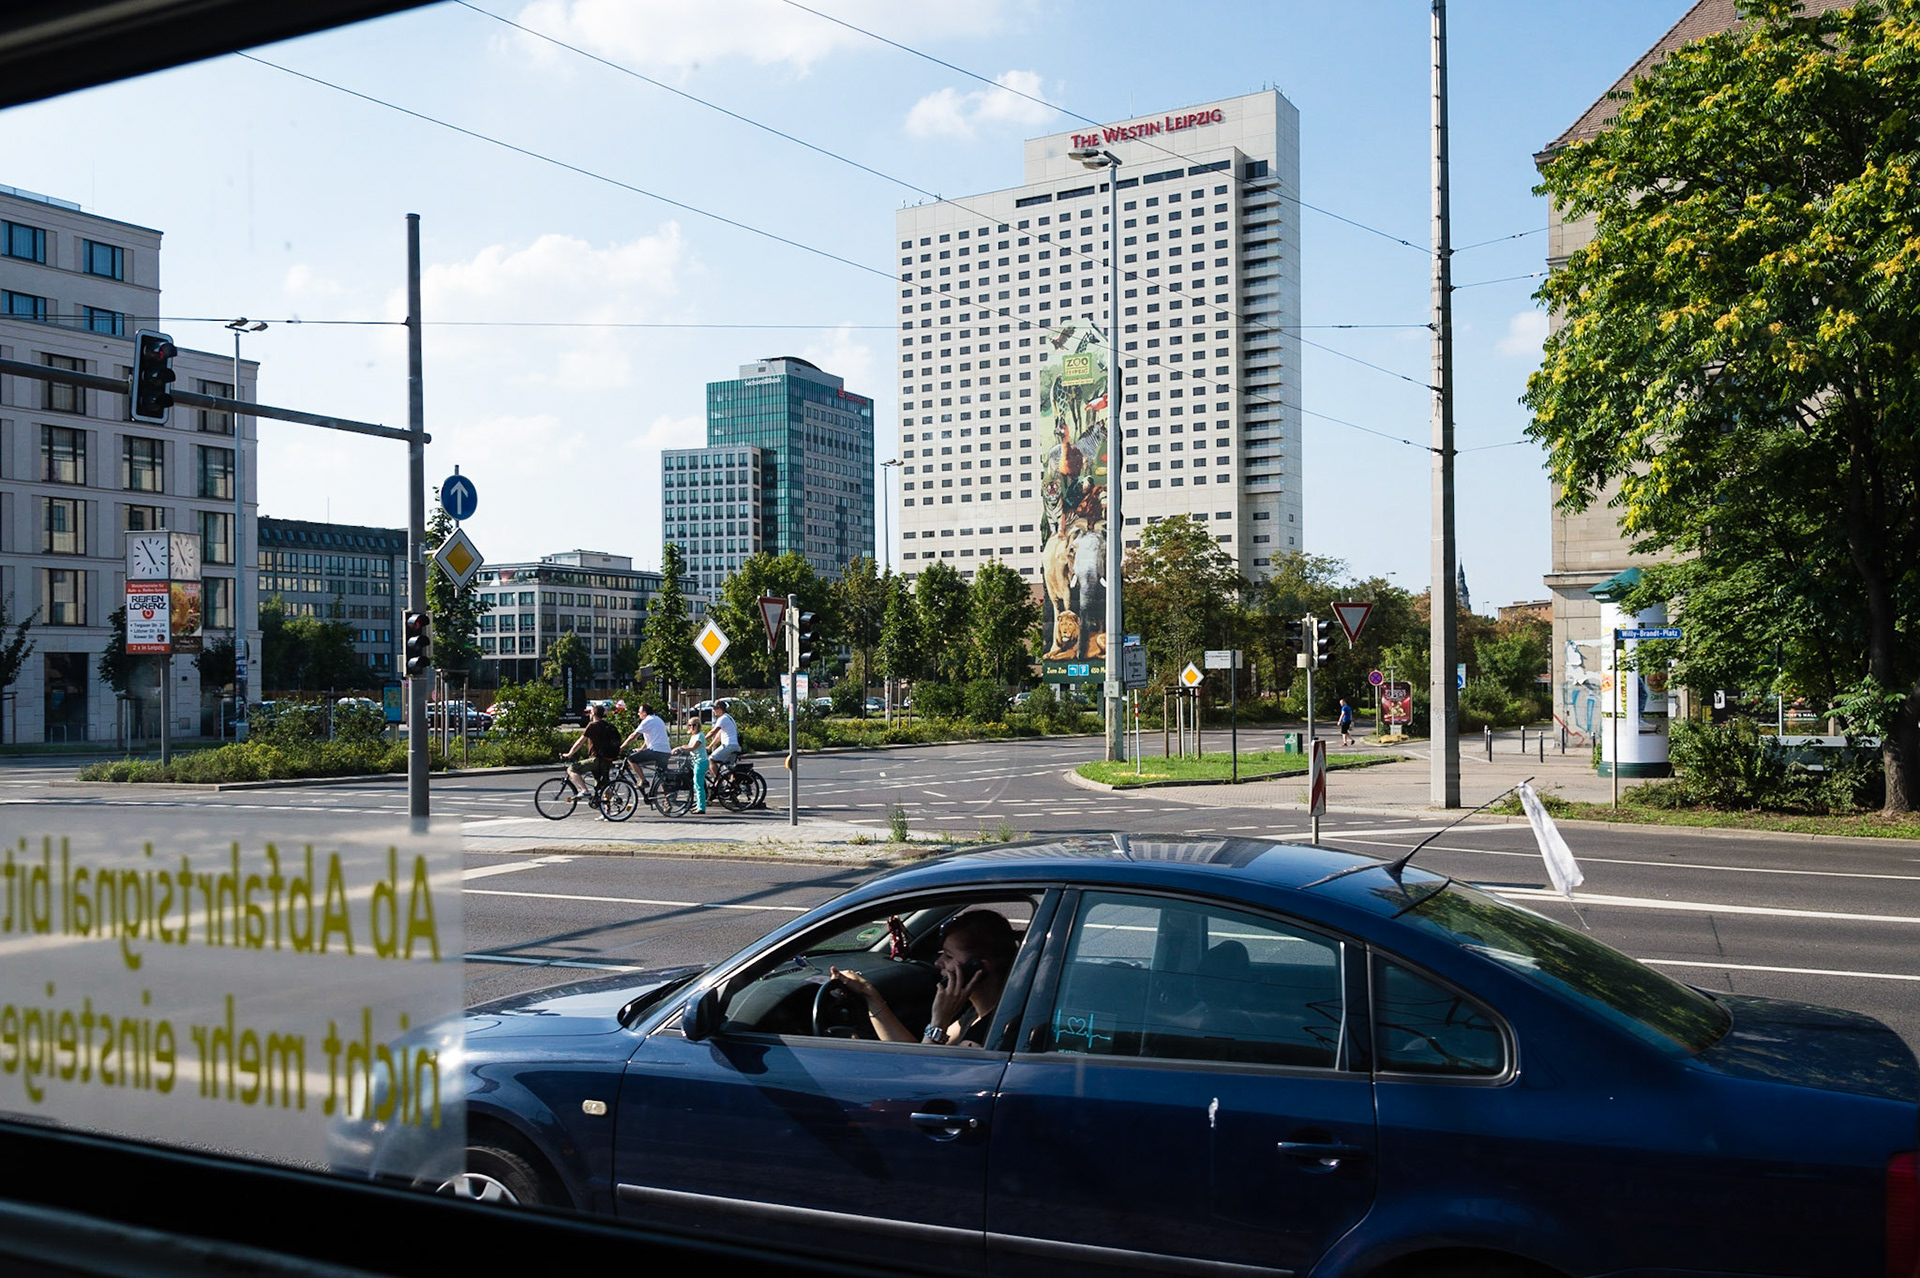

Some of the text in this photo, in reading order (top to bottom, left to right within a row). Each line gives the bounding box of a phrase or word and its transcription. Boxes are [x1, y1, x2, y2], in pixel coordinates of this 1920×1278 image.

[1071, 108, 1223, 149] THE WESTIN LEIPZIG
[1066, 357, 1089, 367] ZOO
[131, 595, 164, 603] REIFEN
[129, 602, 167, 610] LORENZ
[1621, 629, 1678, 638] Willy-Brandt-Platz
